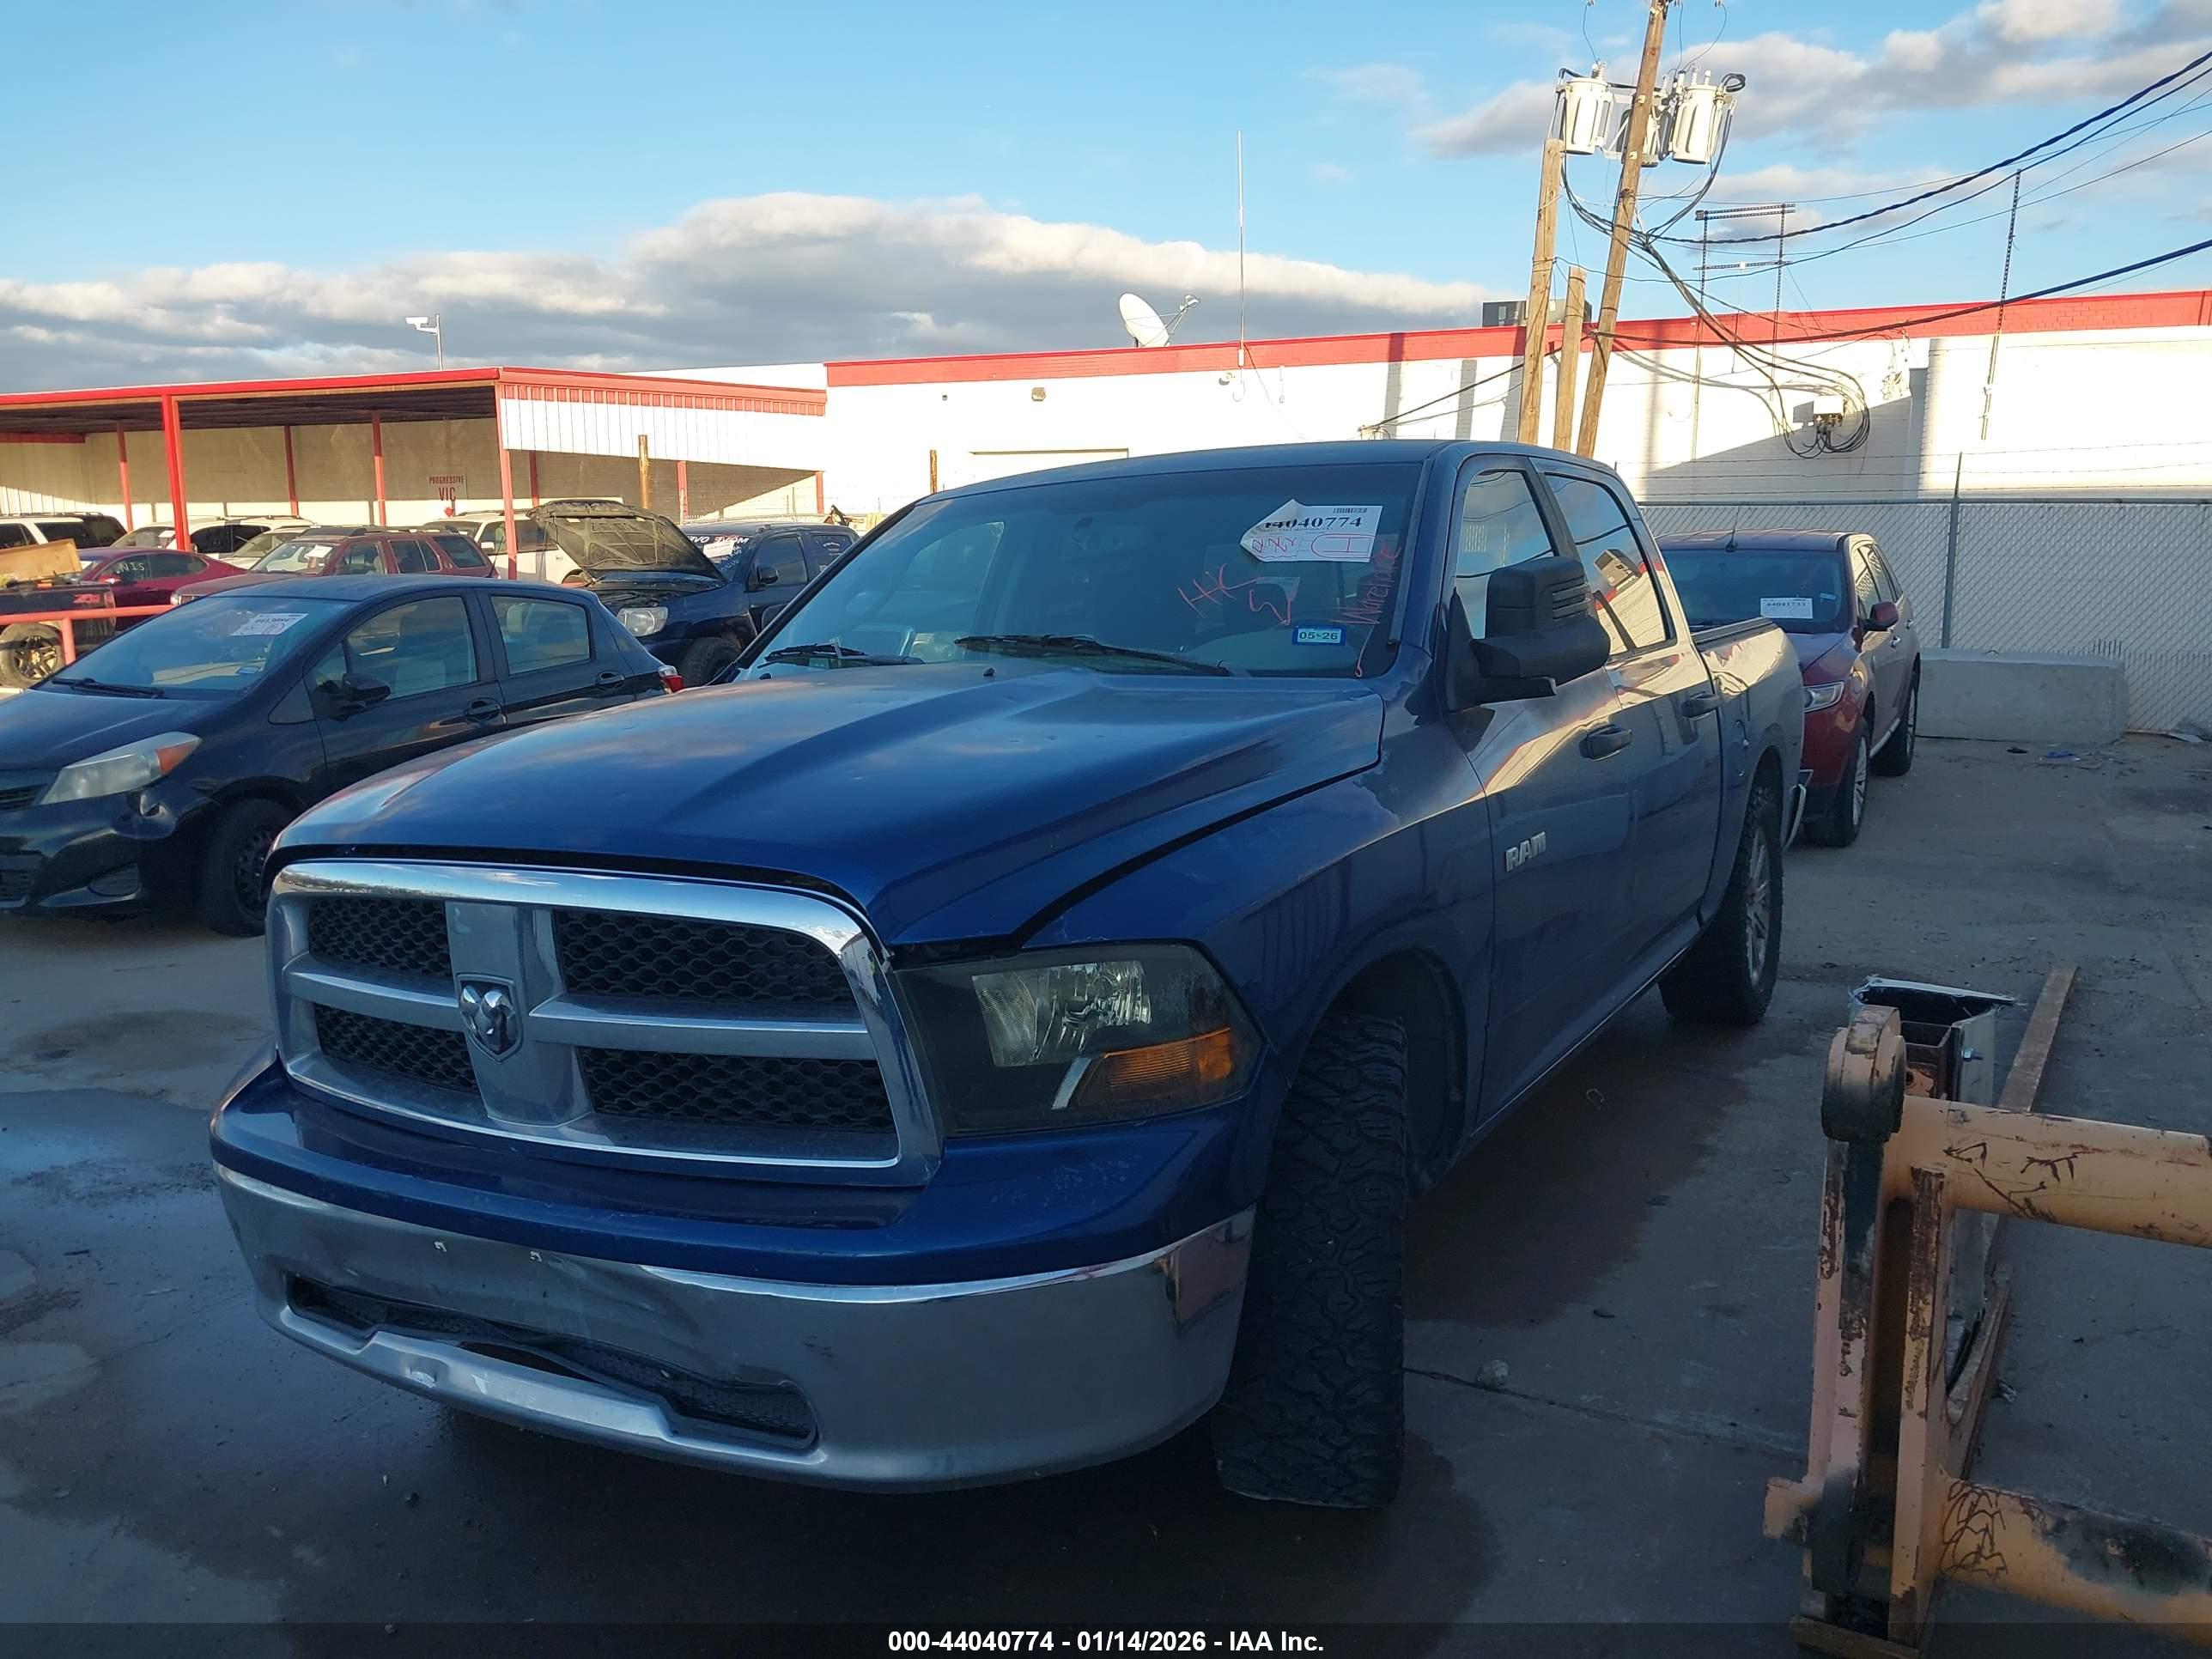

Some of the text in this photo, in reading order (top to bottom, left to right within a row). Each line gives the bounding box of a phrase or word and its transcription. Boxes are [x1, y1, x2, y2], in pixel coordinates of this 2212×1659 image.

[428, 476, 465, 484] PROGRESSIVE
[438, 487, 456, 501] VIC
[1505, 831, 1547, 872] RAM
